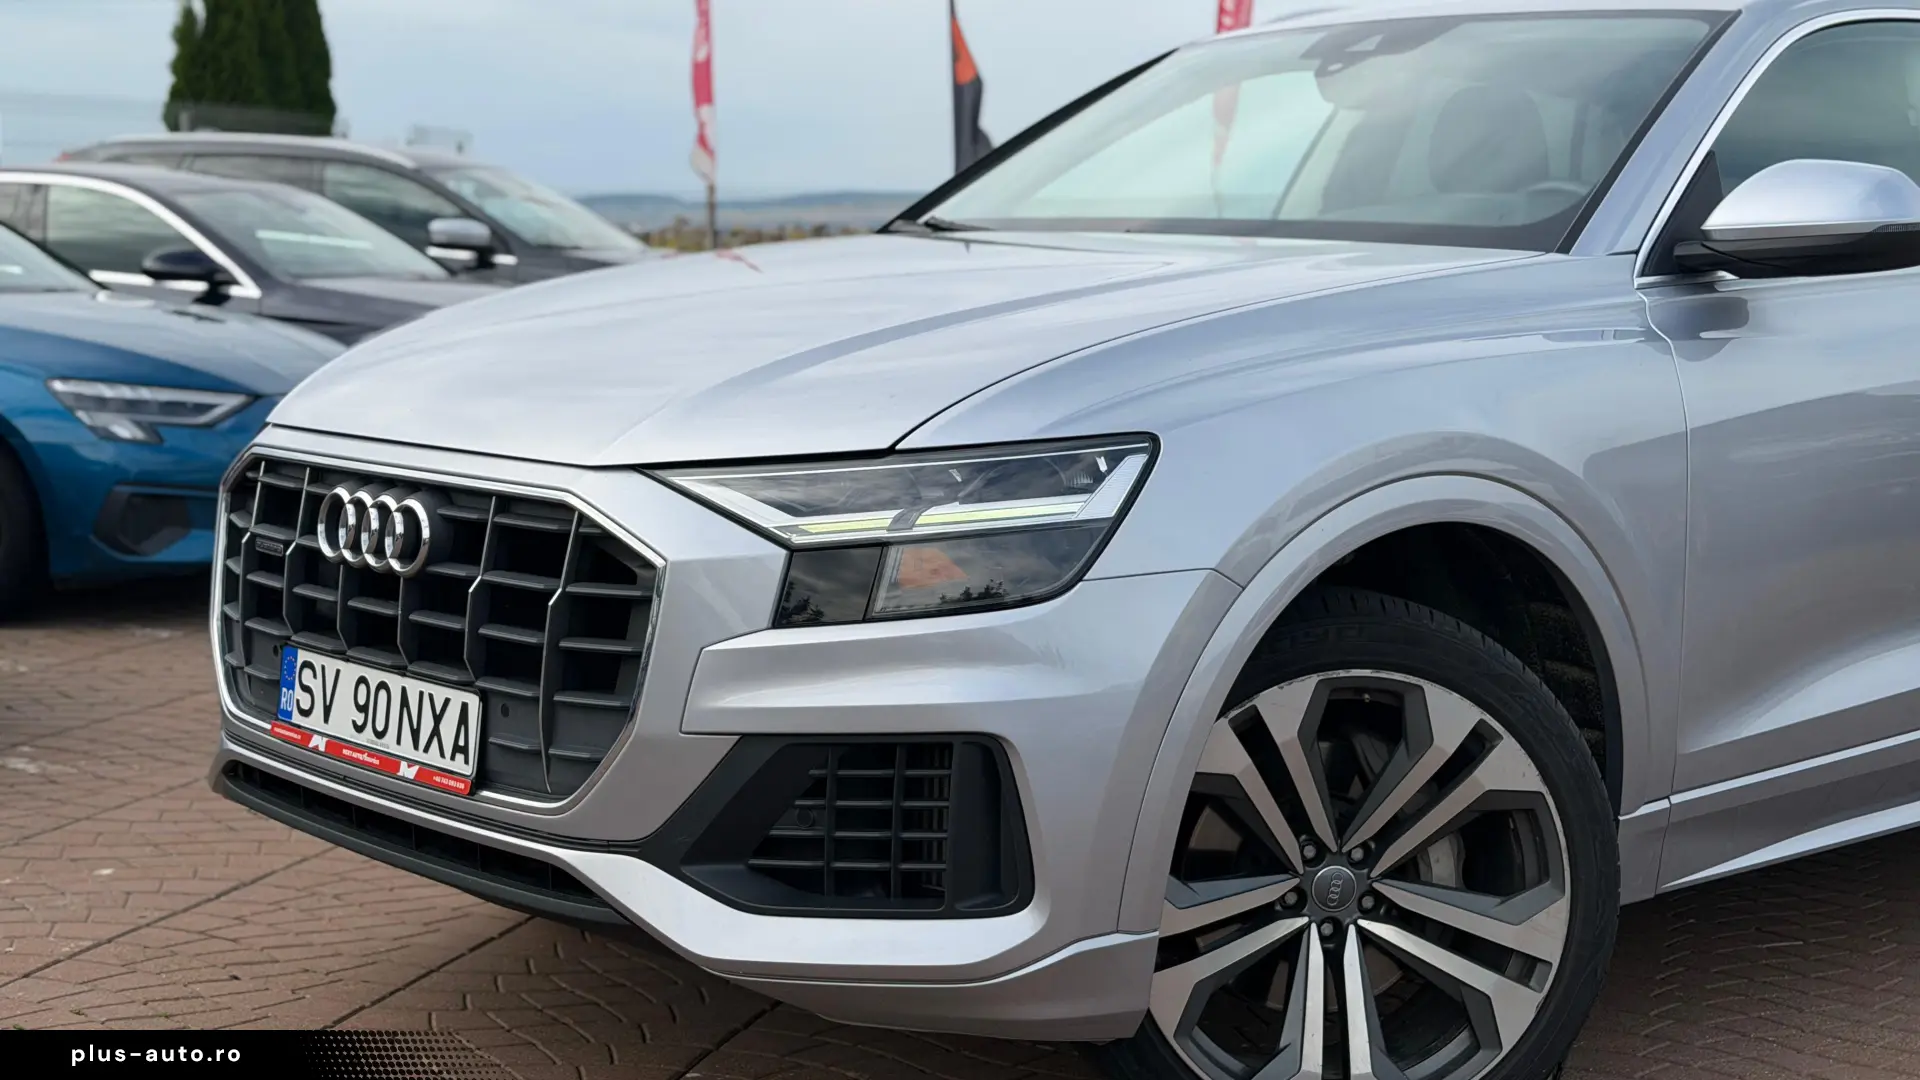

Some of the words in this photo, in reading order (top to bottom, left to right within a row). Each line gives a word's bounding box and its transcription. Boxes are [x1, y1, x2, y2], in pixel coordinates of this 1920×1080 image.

[280, 687, 294, 712] RO
[296, 659, 341, 725] SV
[352, 675, 392, 740] 90
[396, 685, 470, 766] NXA
